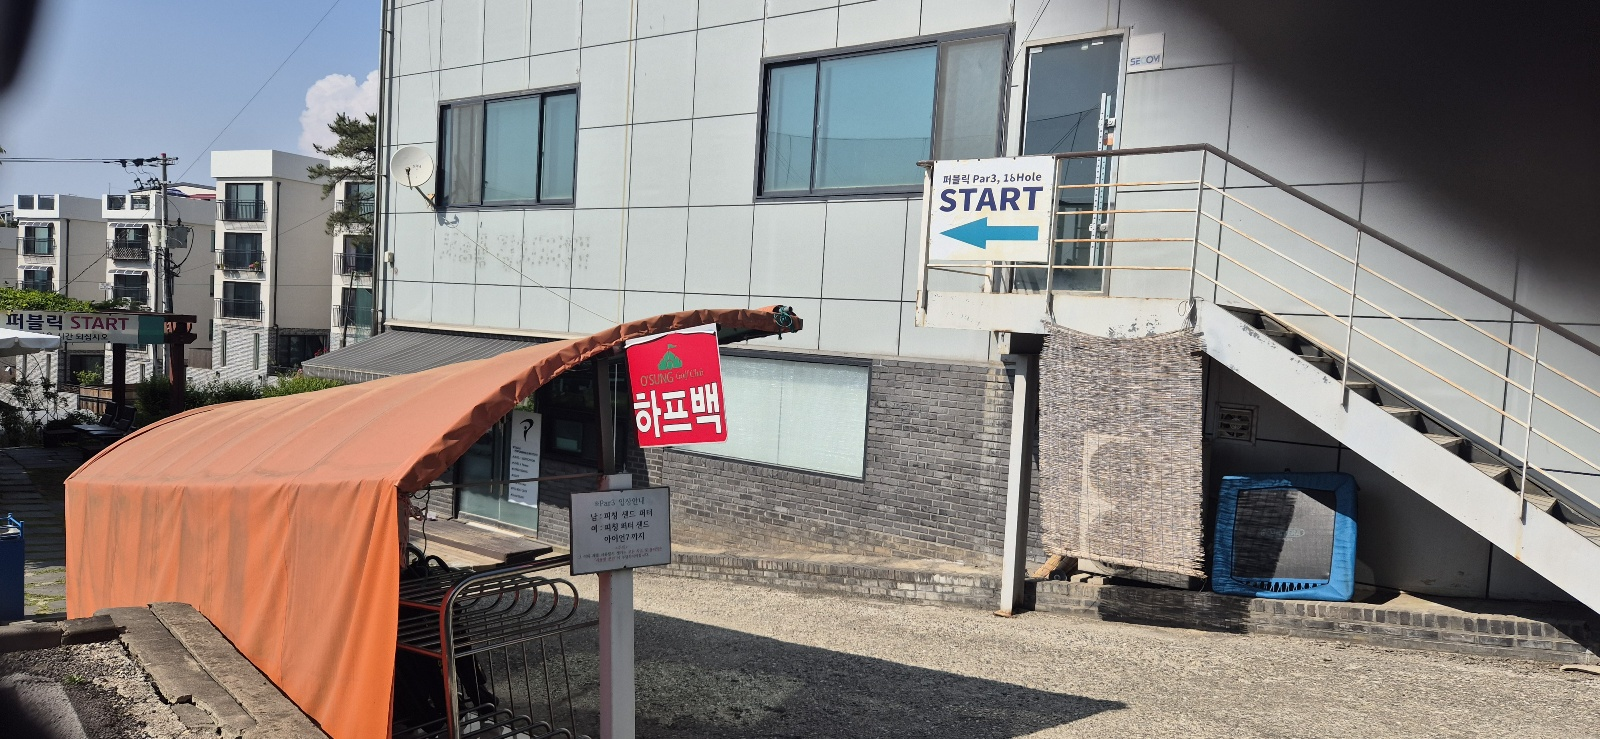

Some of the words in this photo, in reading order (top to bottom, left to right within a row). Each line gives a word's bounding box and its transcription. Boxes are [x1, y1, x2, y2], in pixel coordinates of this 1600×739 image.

[942, 174, 970, 185] 퍼블릭
[973, 173, 1001, 185] Par3,
[939, 186, 1044, 213] START
[5, 313, 63, 331] 퍼블릭
[70, 315, 129, 331] START
[640, 372, 674, 387] O'SUNG
[633, 382, 722, 438] 하프백
